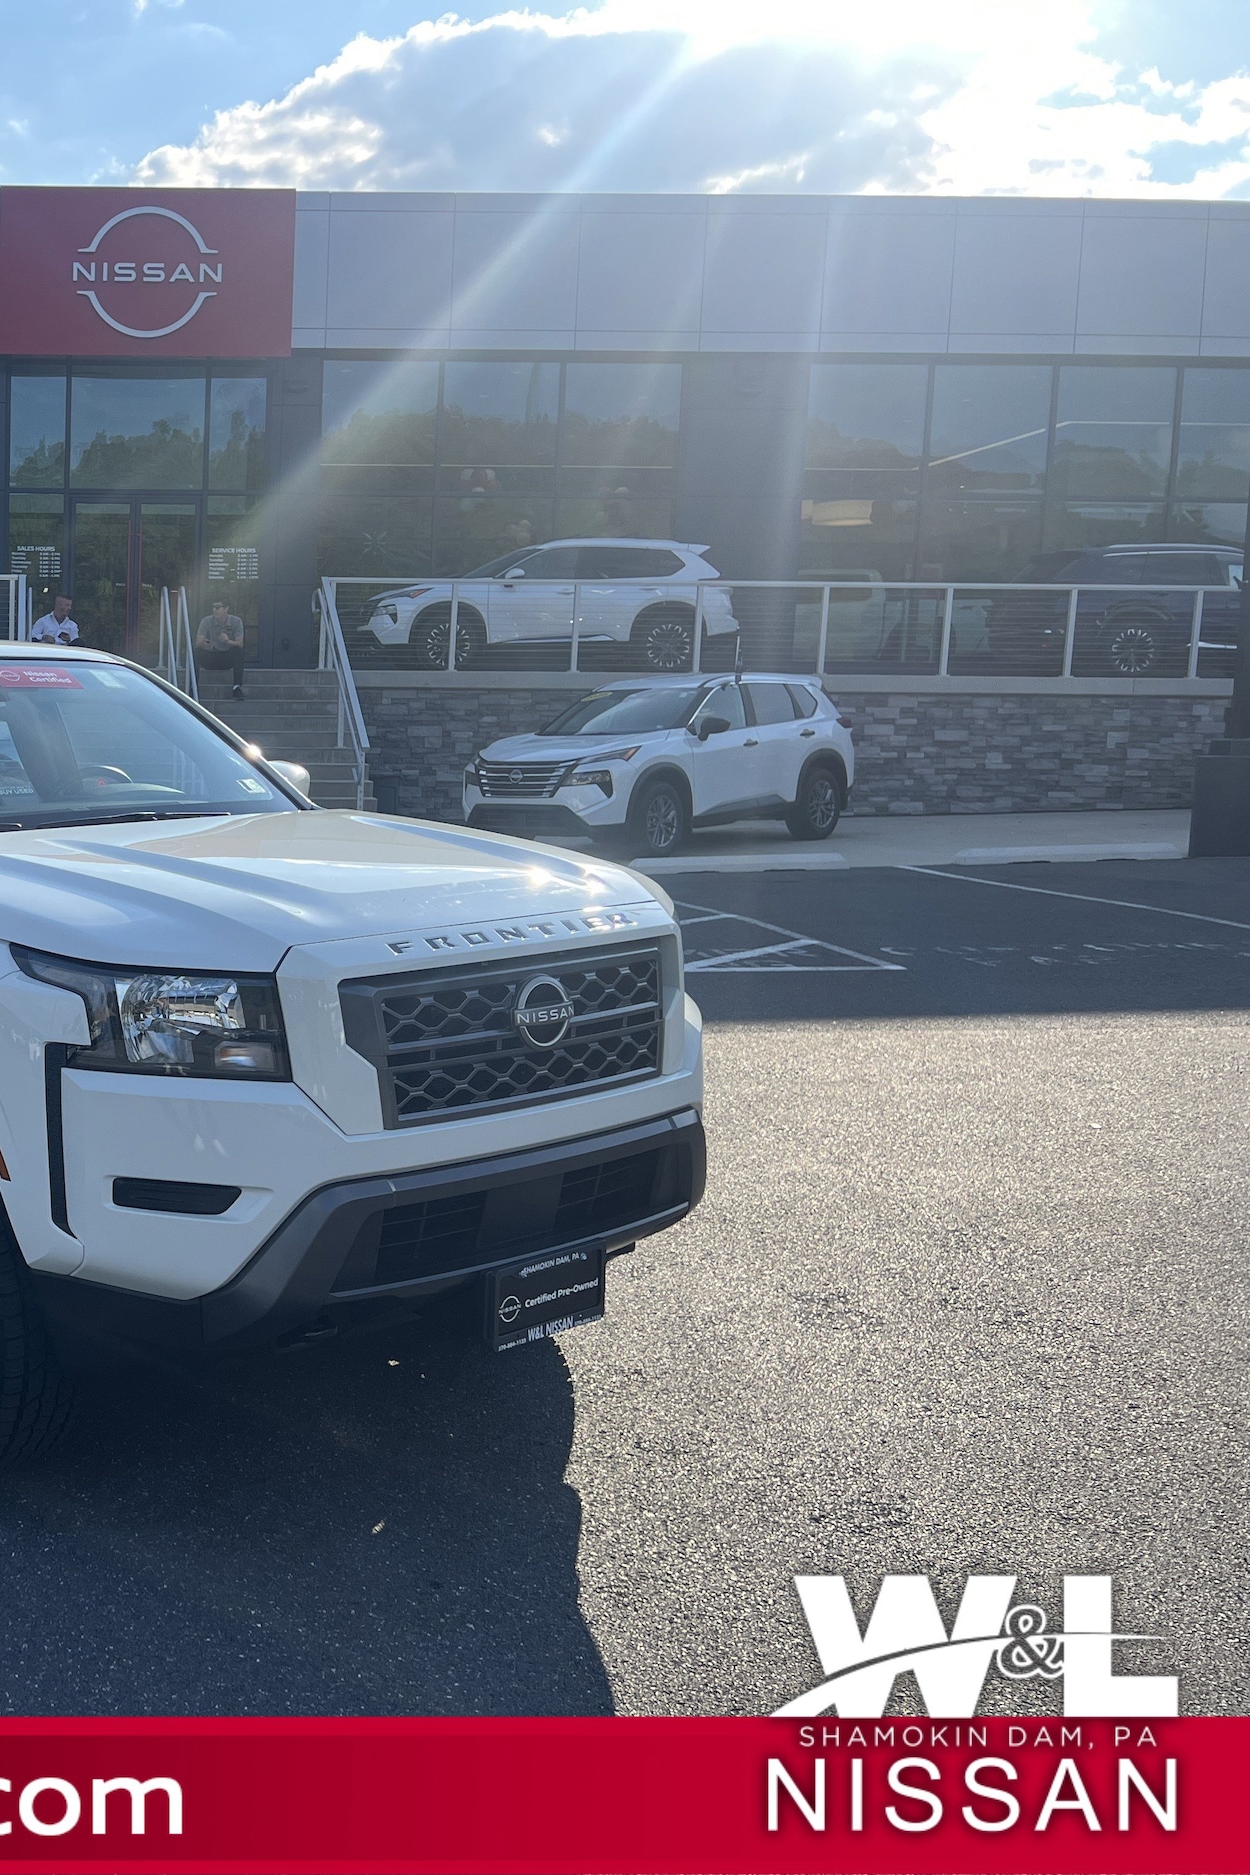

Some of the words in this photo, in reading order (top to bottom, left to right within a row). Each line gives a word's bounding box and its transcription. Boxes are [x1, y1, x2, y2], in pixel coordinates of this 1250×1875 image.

[72, 261, 223, 283] NISSAN
[23, 670, 58, 678] Nissan
[30, 676, 72, 684] Certified
[386, 911, 638, 956] FRONTIER
[517, 1004, 575, 1025] NISSAN
[523, 1258, 555, 1275] SHAMOKIN
[571, 1252, 580, 1262] PA
[524, 1291, 557, 1308] Certified
[557, 1278, 599, 1299] Pre-Owned
[527, 1327, 545, 1342] W&L
[546, 1315, 574, 1337] NISSAN
